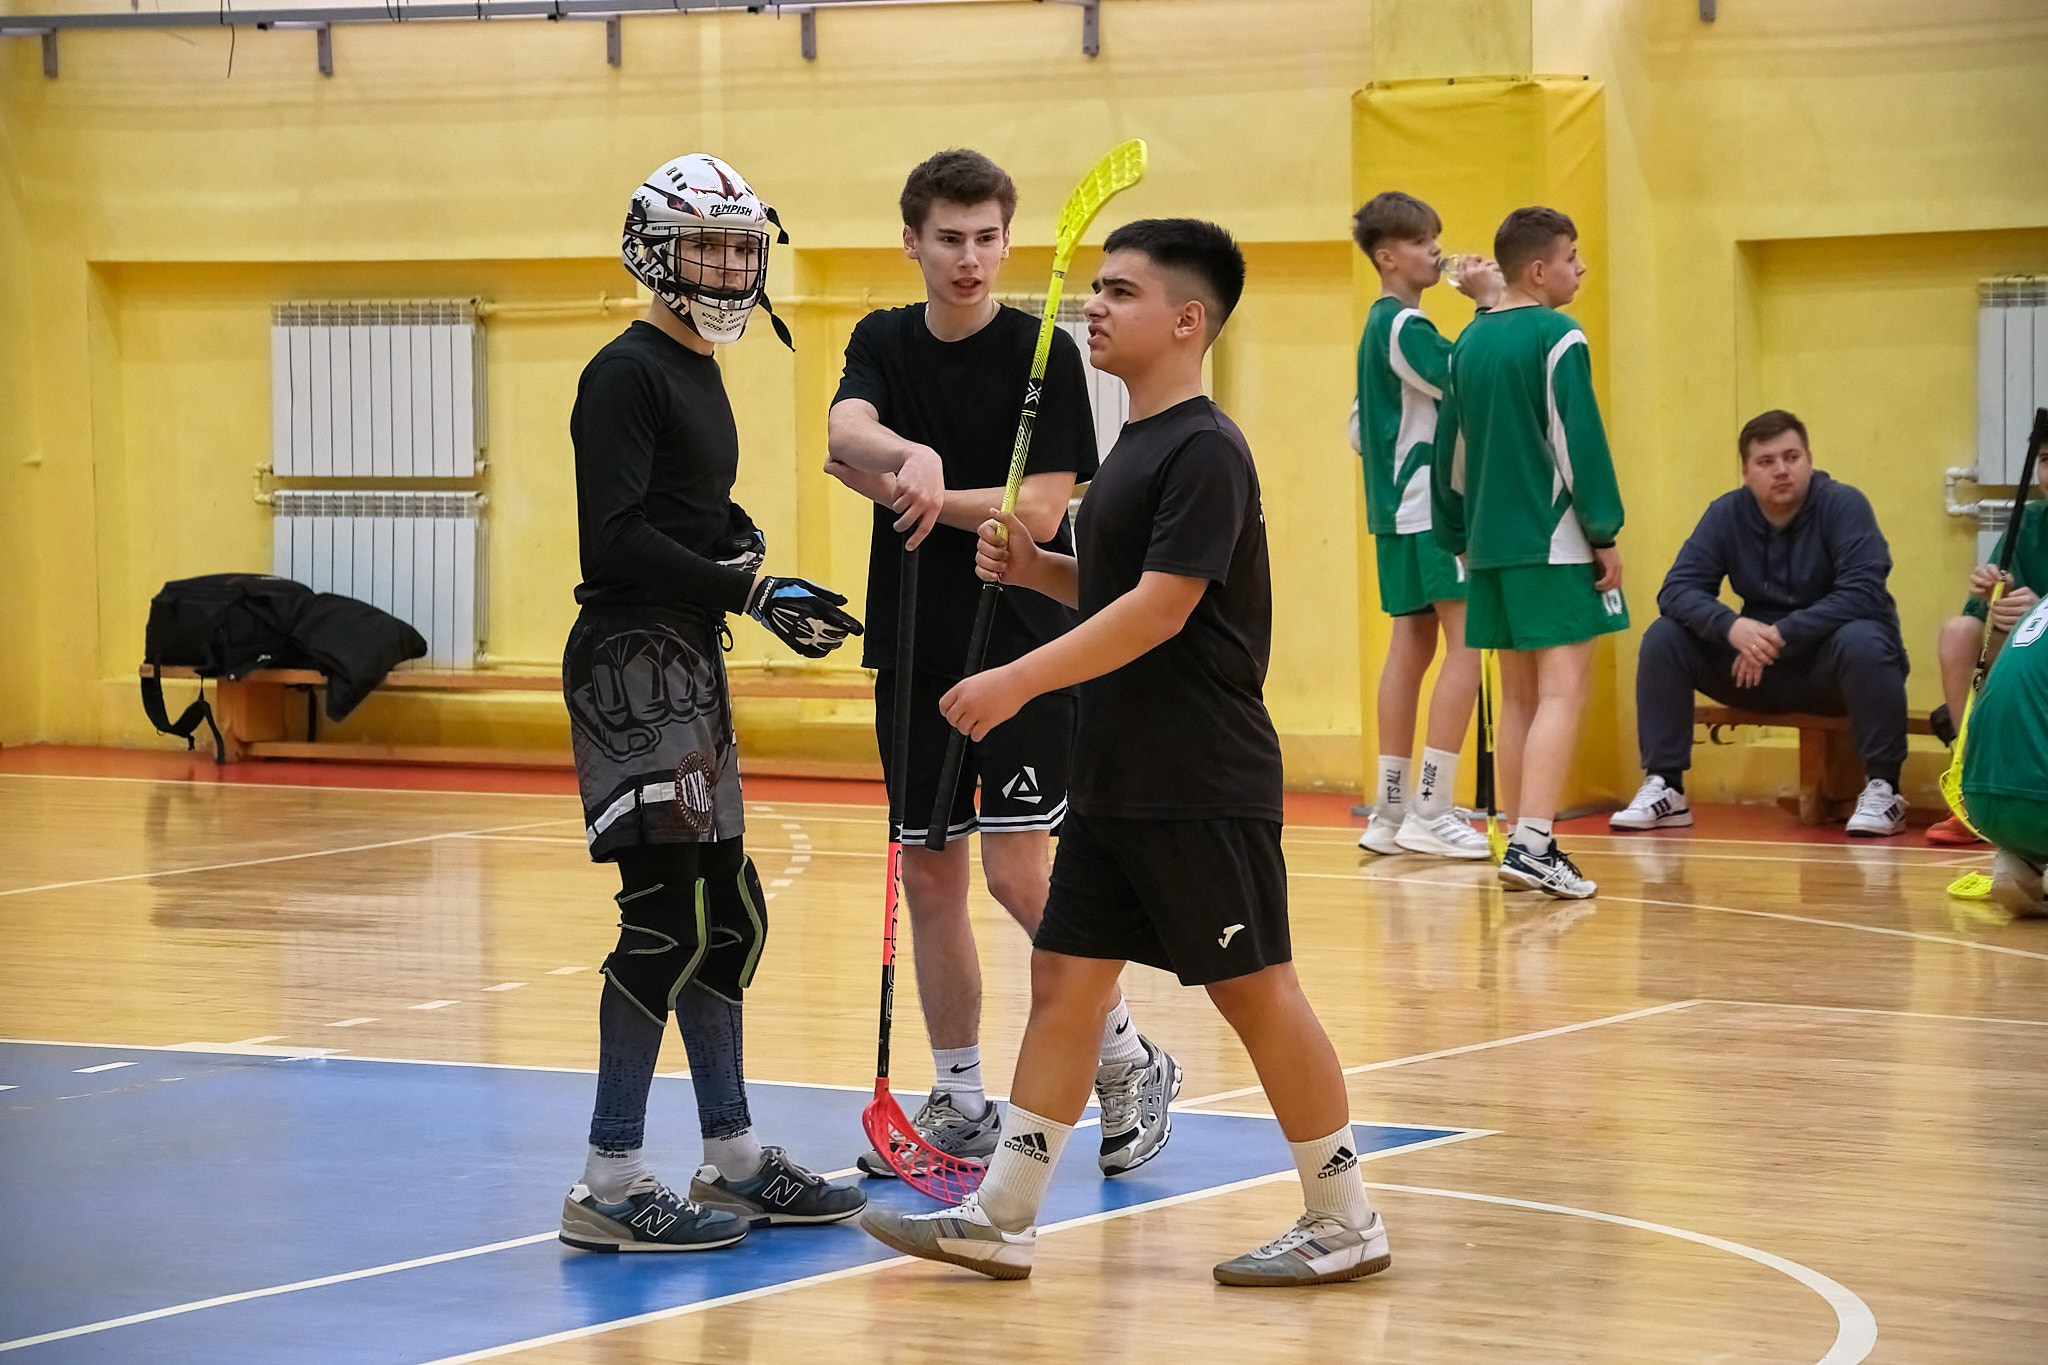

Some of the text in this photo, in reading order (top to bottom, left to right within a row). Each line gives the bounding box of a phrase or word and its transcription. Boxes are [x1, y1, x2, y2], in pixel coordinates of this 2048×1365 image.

[710, 204, 752, 216] TEMPISH
[1386, 769, 1401, 786] ALL
[719, 1129, 749, 1141] adidas
[595, 1150, 628, 1159] adidas
[1004, 1139, 1050, 1164] adidas
[1317, 1156, 1358, 1179] adidas
